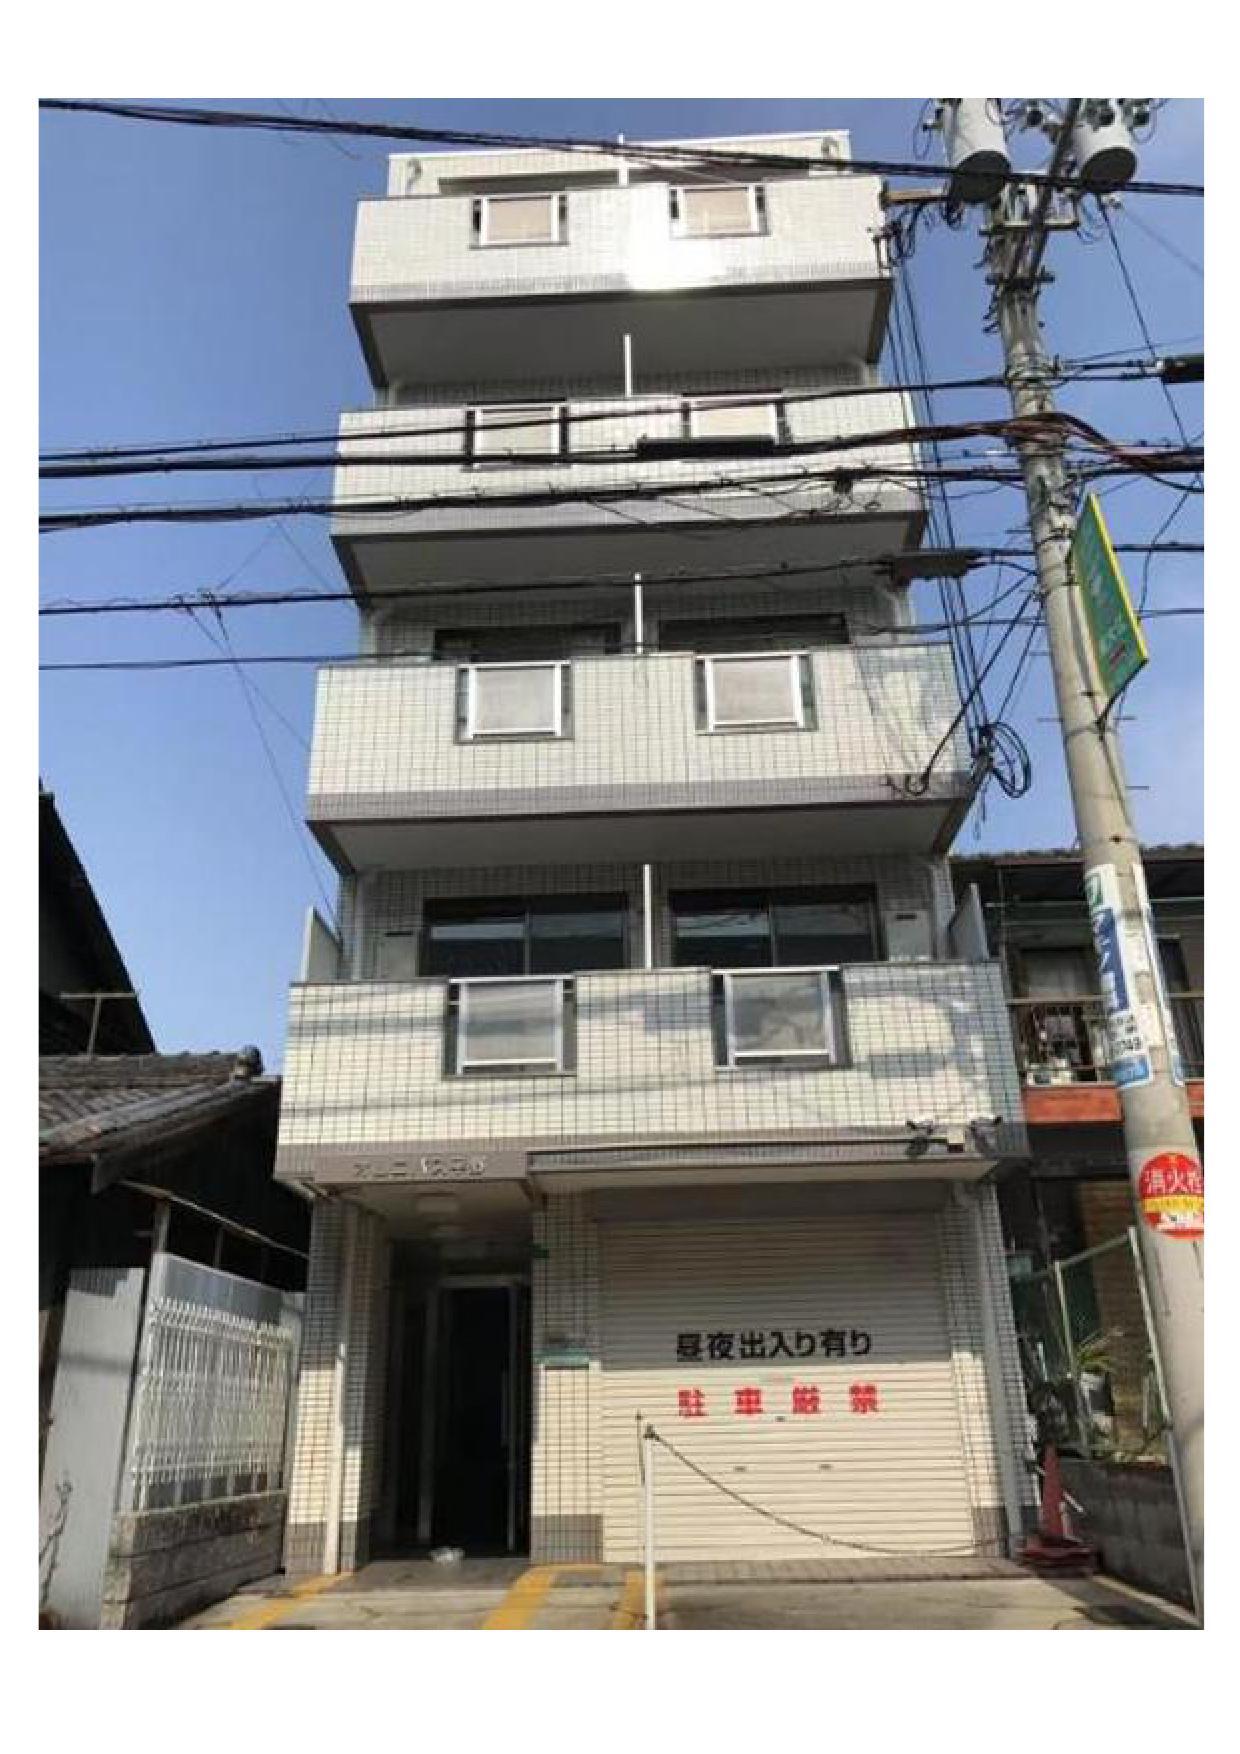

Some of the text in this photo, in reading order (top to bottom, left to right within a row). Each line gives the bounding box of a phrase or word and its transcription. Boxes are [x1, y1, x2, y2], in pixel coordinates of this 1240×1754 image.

[676, 1328, 872, 1362] 昼夜出入り有り
[678, 1384, 879, 1417] 駐車厳禁
